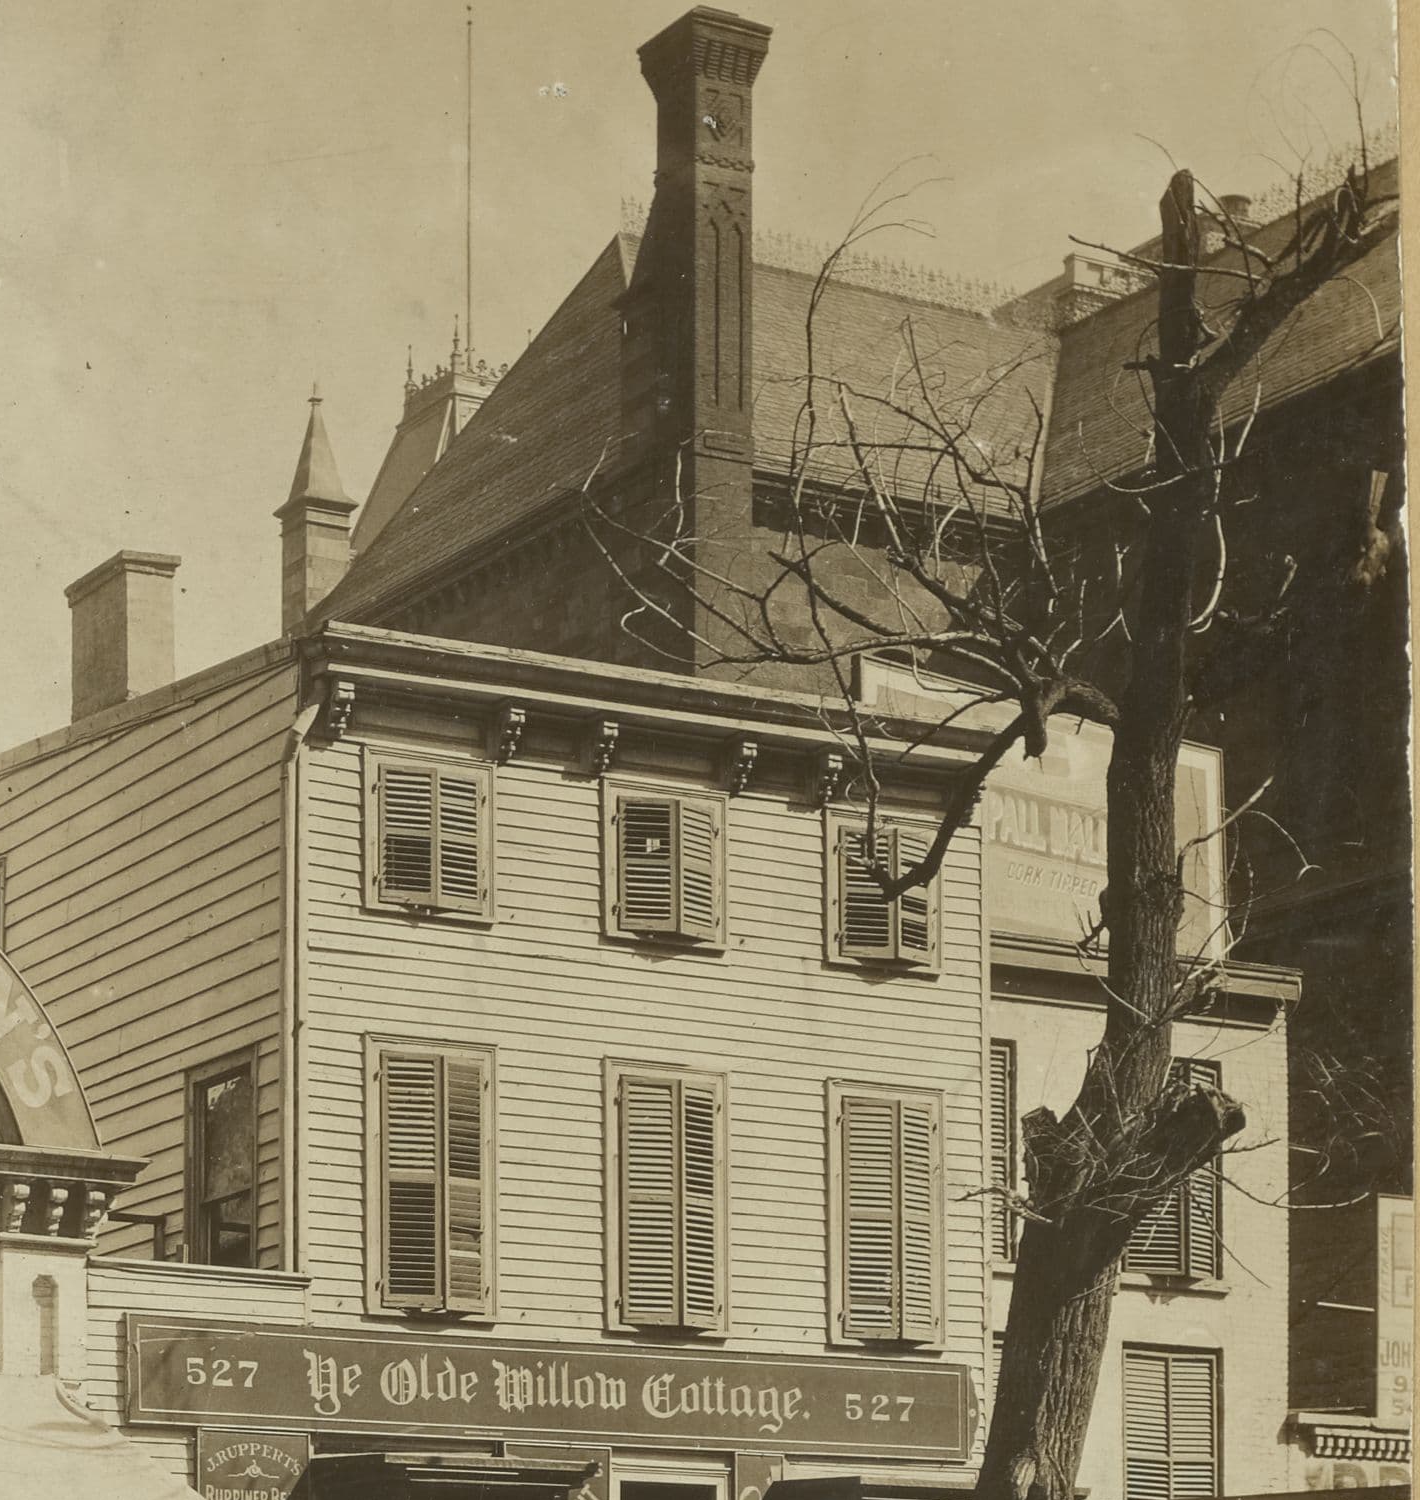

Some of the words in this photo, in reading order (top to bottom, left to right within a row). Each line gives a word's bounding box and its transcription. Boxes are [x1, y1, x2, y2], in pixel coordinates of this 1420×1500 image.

[988, 795, 1046, 852] PALL
[1007, 860, 1044, 887] CORK
[1051, 871, 1099, 898] TIPPED
[185, 1356, 260, 1389] 527
[303, 1348, 364, 1417] Ye
[380, 1352, 479, 1406] Olde
[492, 1358, 628, 1414] Willow
[642, 1372, 811, 1434] Cottage.
[844, 1393, 917, 1423] 527
